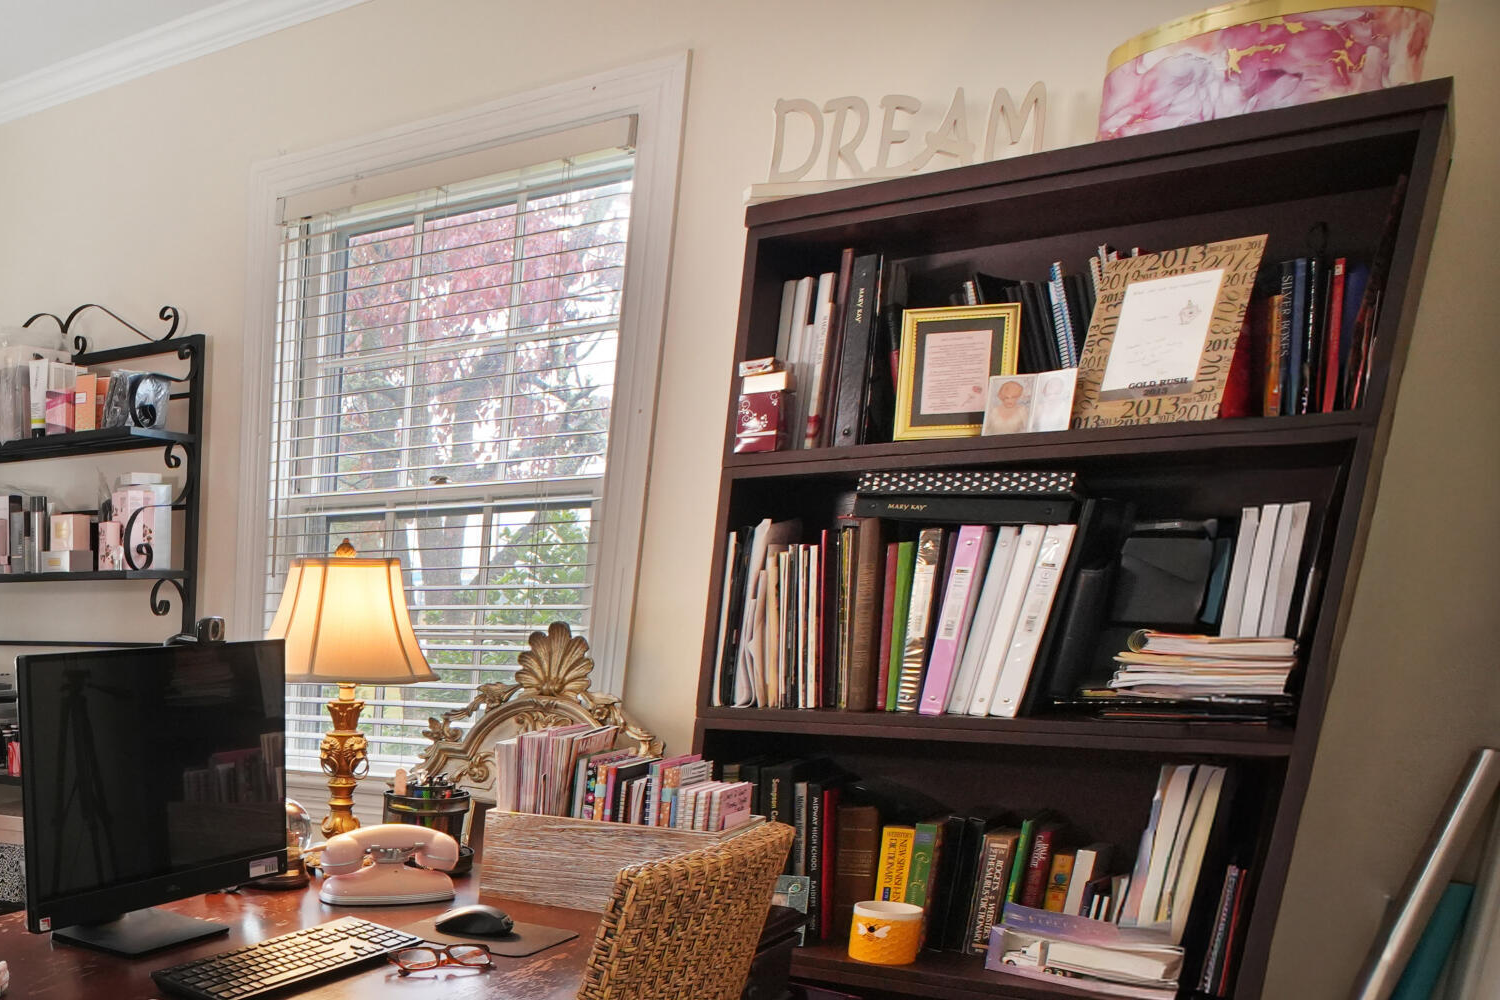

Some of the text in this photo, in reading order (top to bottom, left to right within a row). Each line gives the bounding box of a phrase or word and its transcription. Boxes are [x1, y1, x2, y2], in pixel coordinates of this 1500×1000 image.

[768, 81, 1047, 183] DREAM
[1146, 243, 1208, 272] 2013
[855, 287, 866, 324] MARY KAY
[1280, 275, 1293, 357] SILVER BOXES
[1128, 376, 1189, 390] GOLD RUSH
[1119, 396, 1180, 419] 2013
[887, 503, 927, 511] MARY KAY
[810, 845, 818, 872] SCHOOL
[884, 838, 898, 885] DICTIONARY
[899, 838, 908, 857] NEW
[1030, 835, 1045, 869] CARNEGIE
[990, 860, 1005, 892] ROGET'S
[973, 851, 998, 945] THESAURUS DICTIONARY
[982, 902, 997, 940] WEBSTER'S
